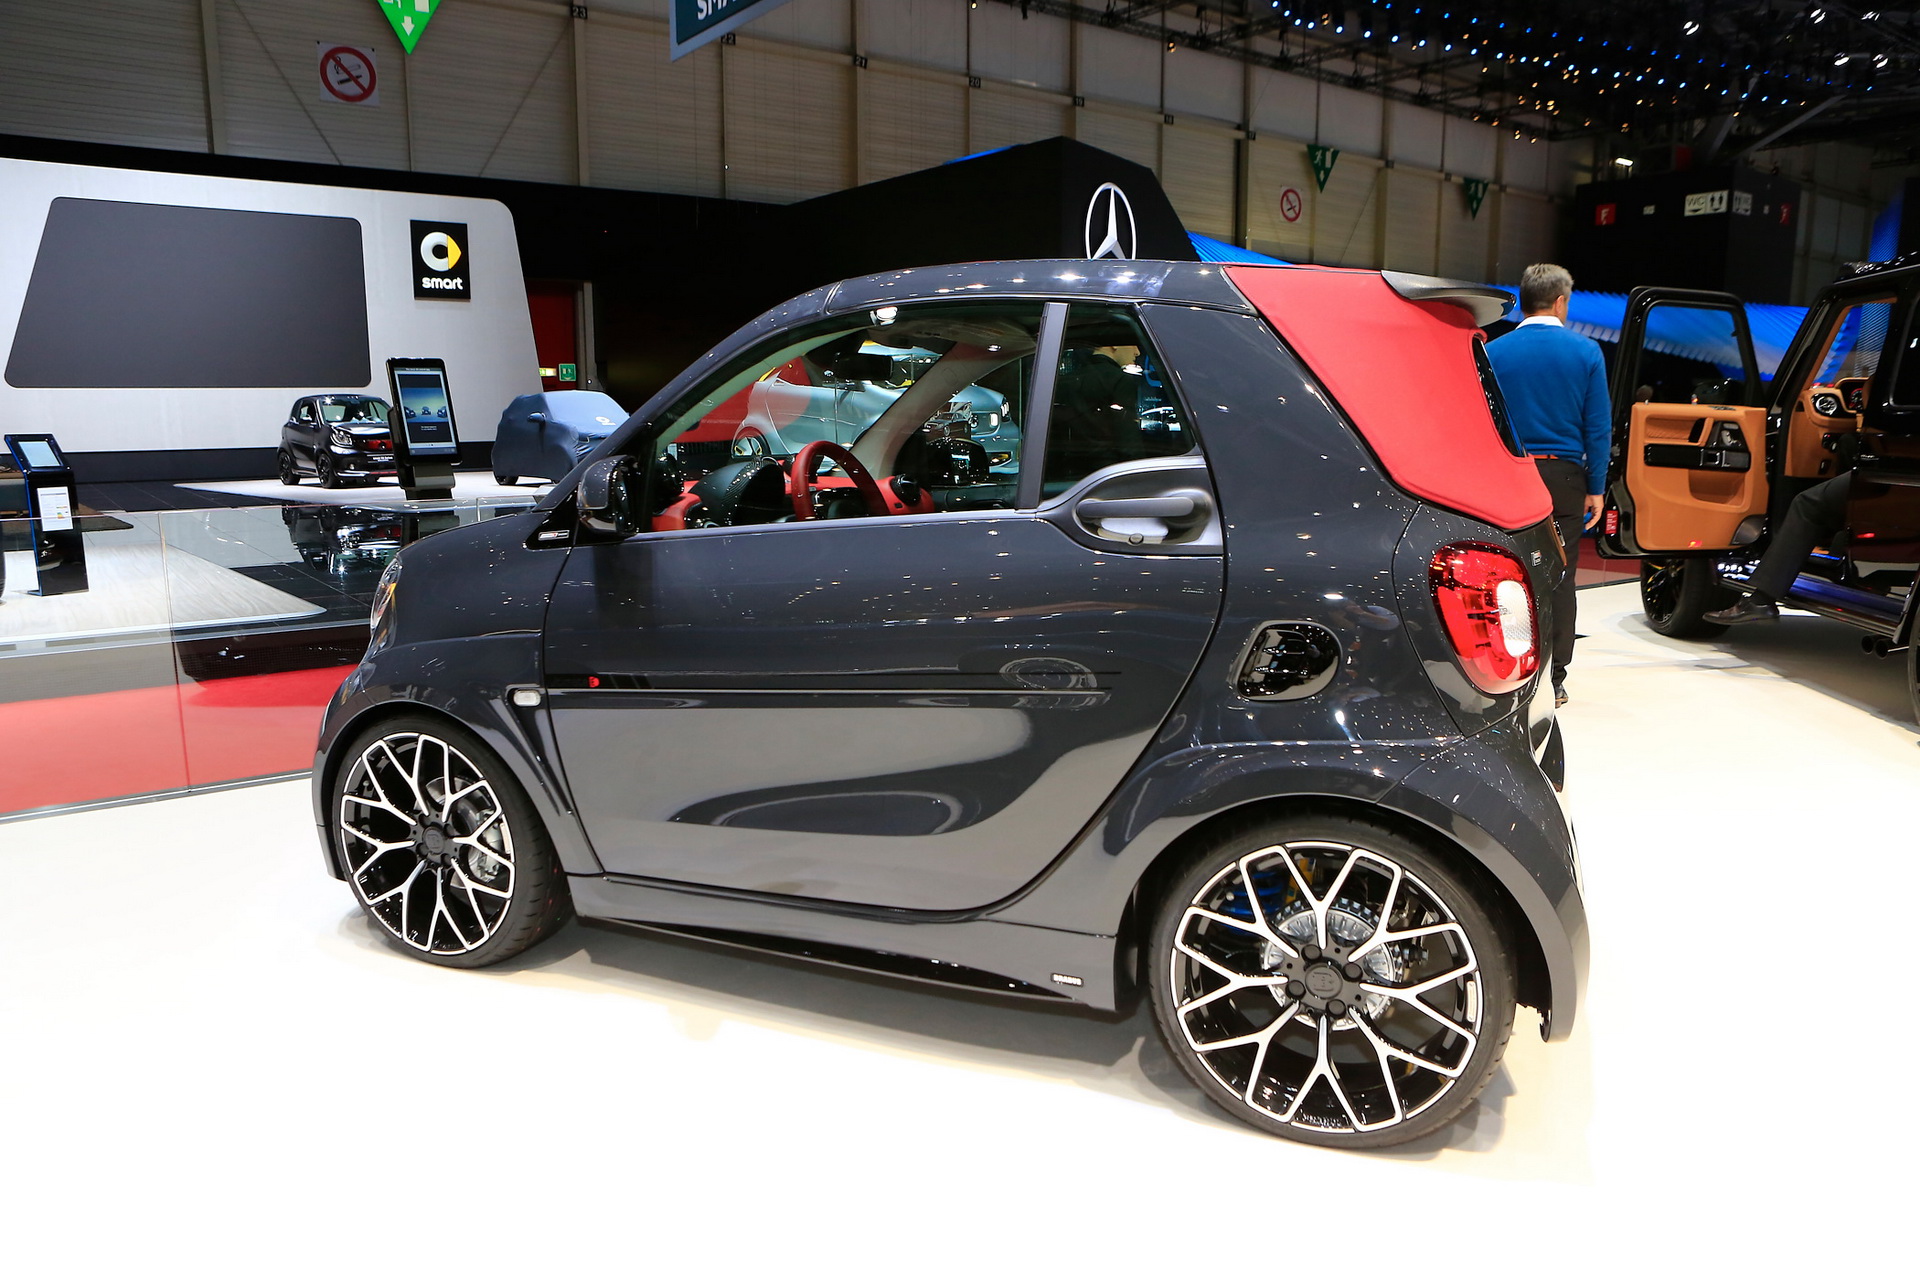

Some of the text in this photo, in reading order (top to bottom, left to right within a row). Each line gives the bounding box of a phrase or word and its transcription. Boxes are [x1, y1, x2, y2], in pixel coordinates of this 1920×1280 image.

[572, 6, 586, 19] 23
[855, 55, 866, 68] 21
[970, 77, 980, 88] 20
[1686, 195, 1705, 207] WC
[422, 276, 463, 290] smart
